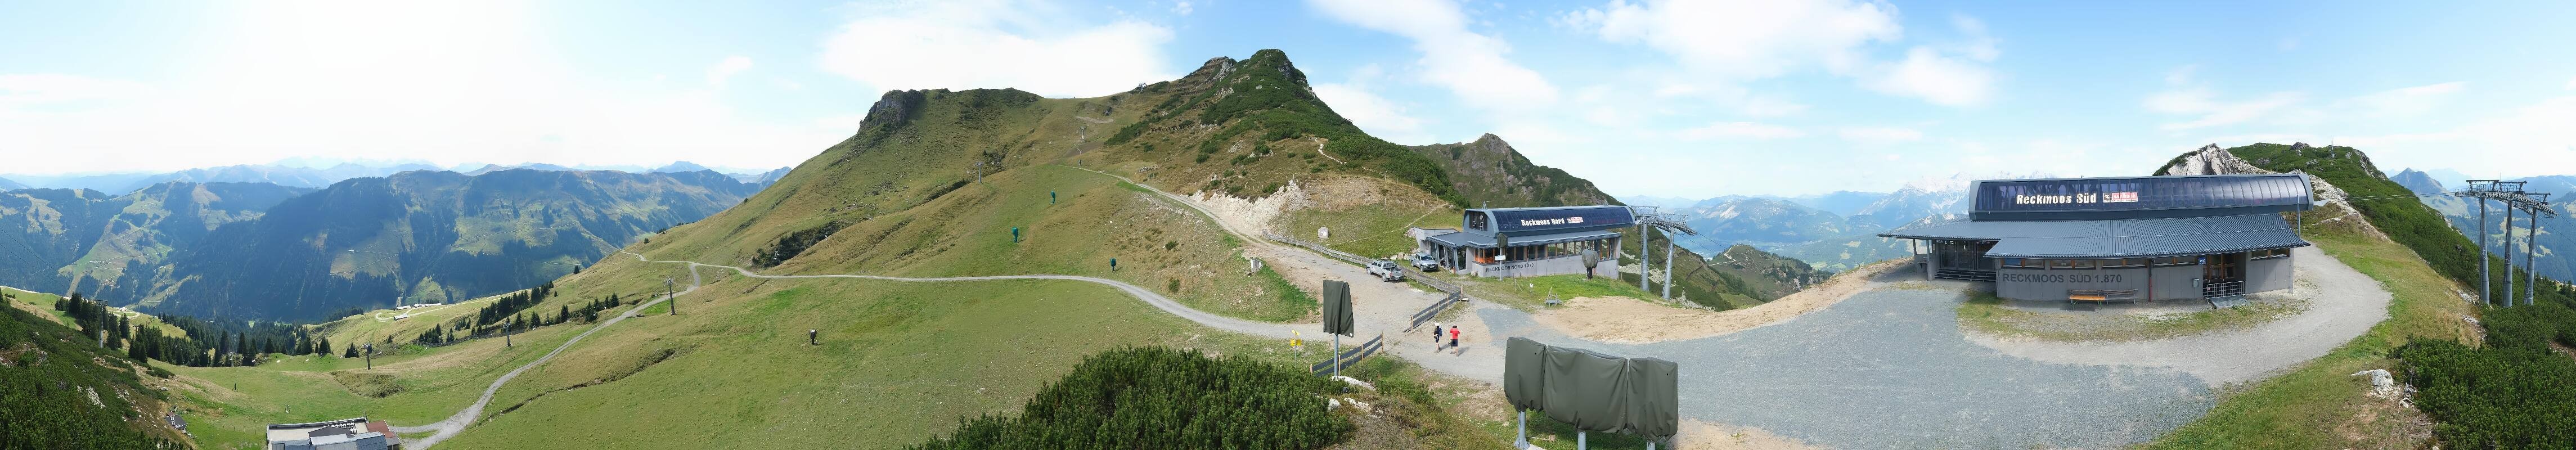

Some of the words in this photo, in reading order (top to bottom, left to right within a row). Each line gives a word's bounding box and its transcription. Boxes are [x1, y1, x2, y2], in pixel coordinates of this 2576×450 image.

[2016, 194, 2072, 204] Reckmoos
[2076, 193, 2096, 204] Süd
[2003, 273, 2064, 283] RECKMOOS
[2069, 273, 2092, 283] SÜD
[2094, 274, 2122, 283] 1.870
